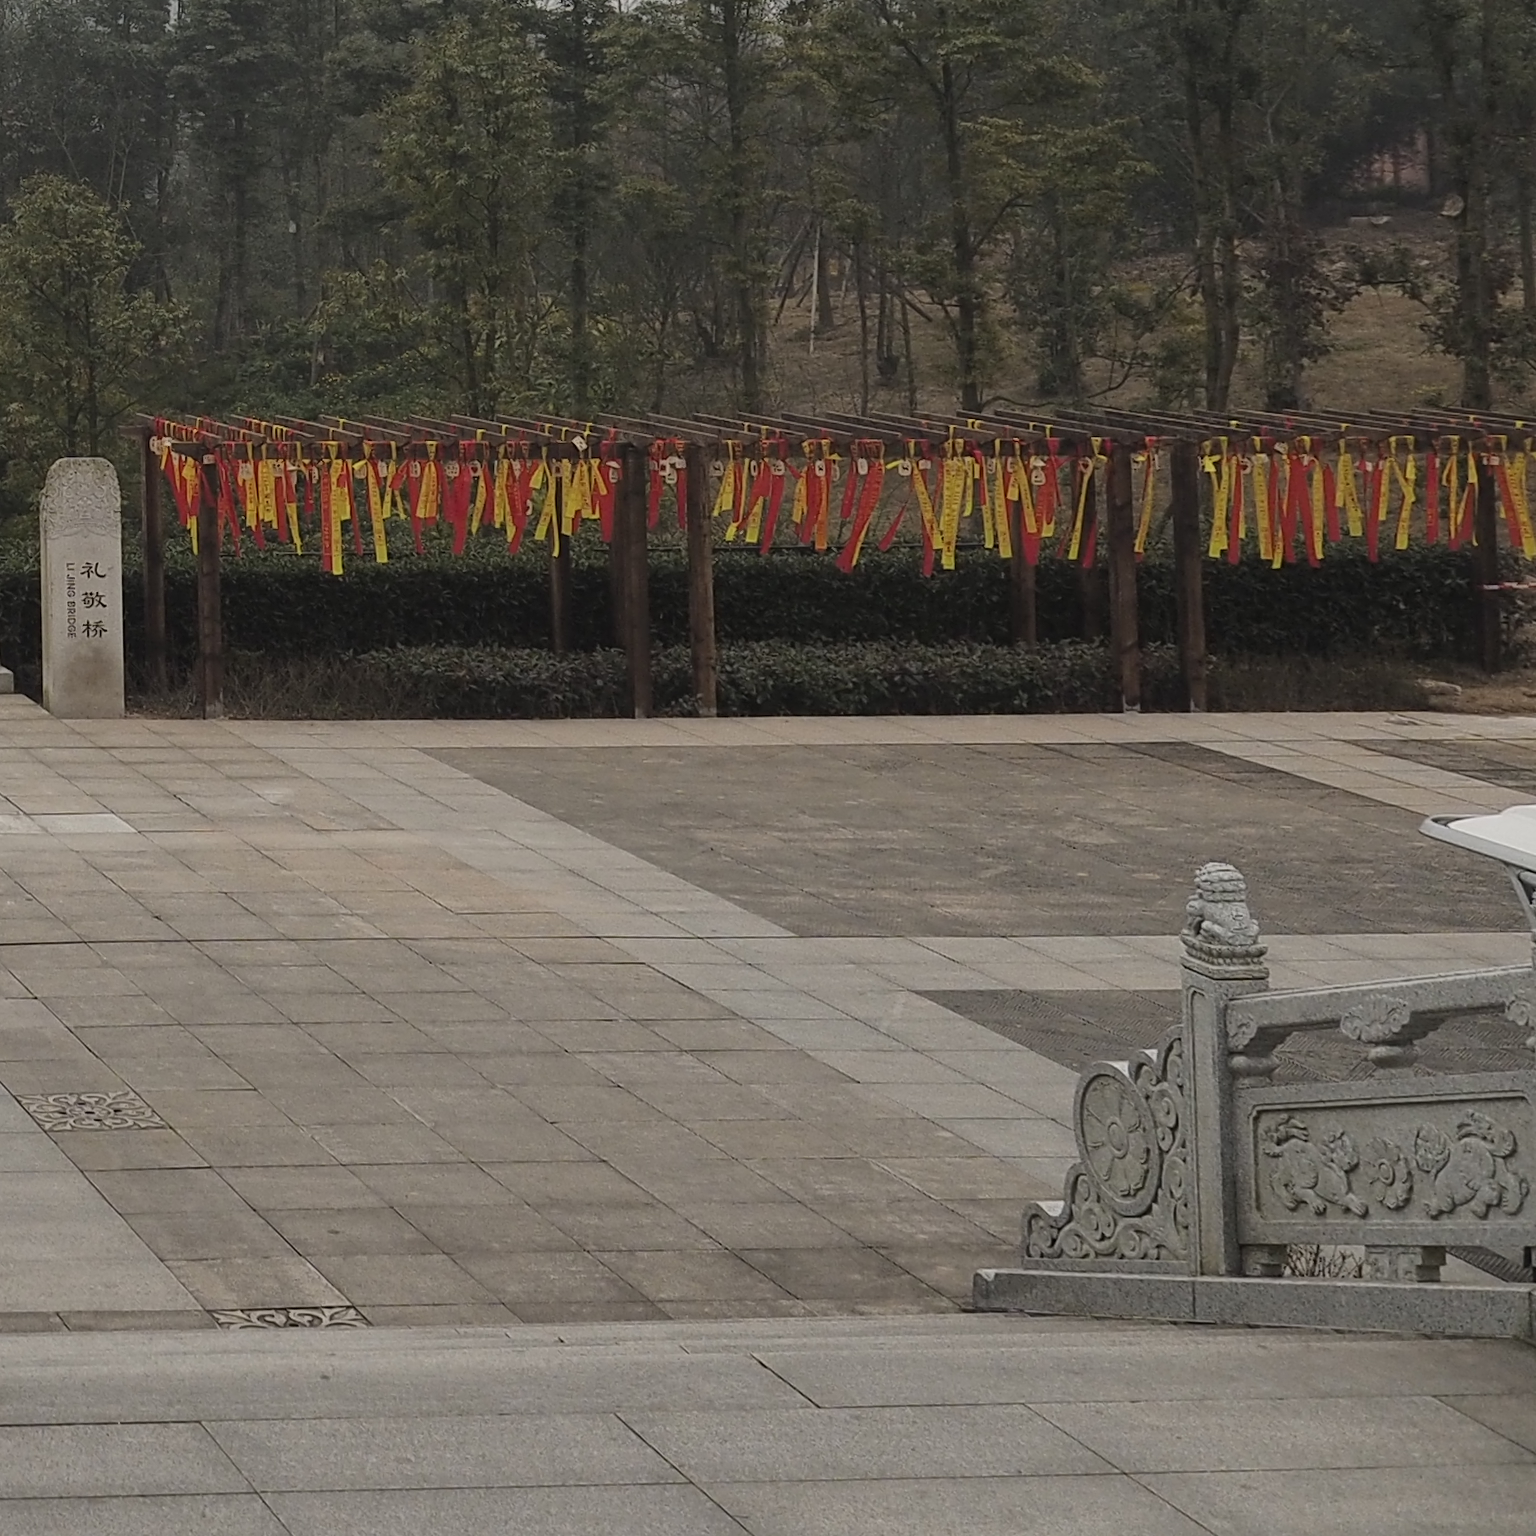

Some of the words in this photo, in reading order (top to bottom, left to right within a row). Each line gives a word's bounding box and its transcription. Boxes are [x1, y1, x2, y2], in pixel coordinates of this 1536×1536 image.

[66, 574, 76, 597] JING
[80, 561, 108, 638] 礼敬桥
[66, 601, 77, 638] BRIDGE
